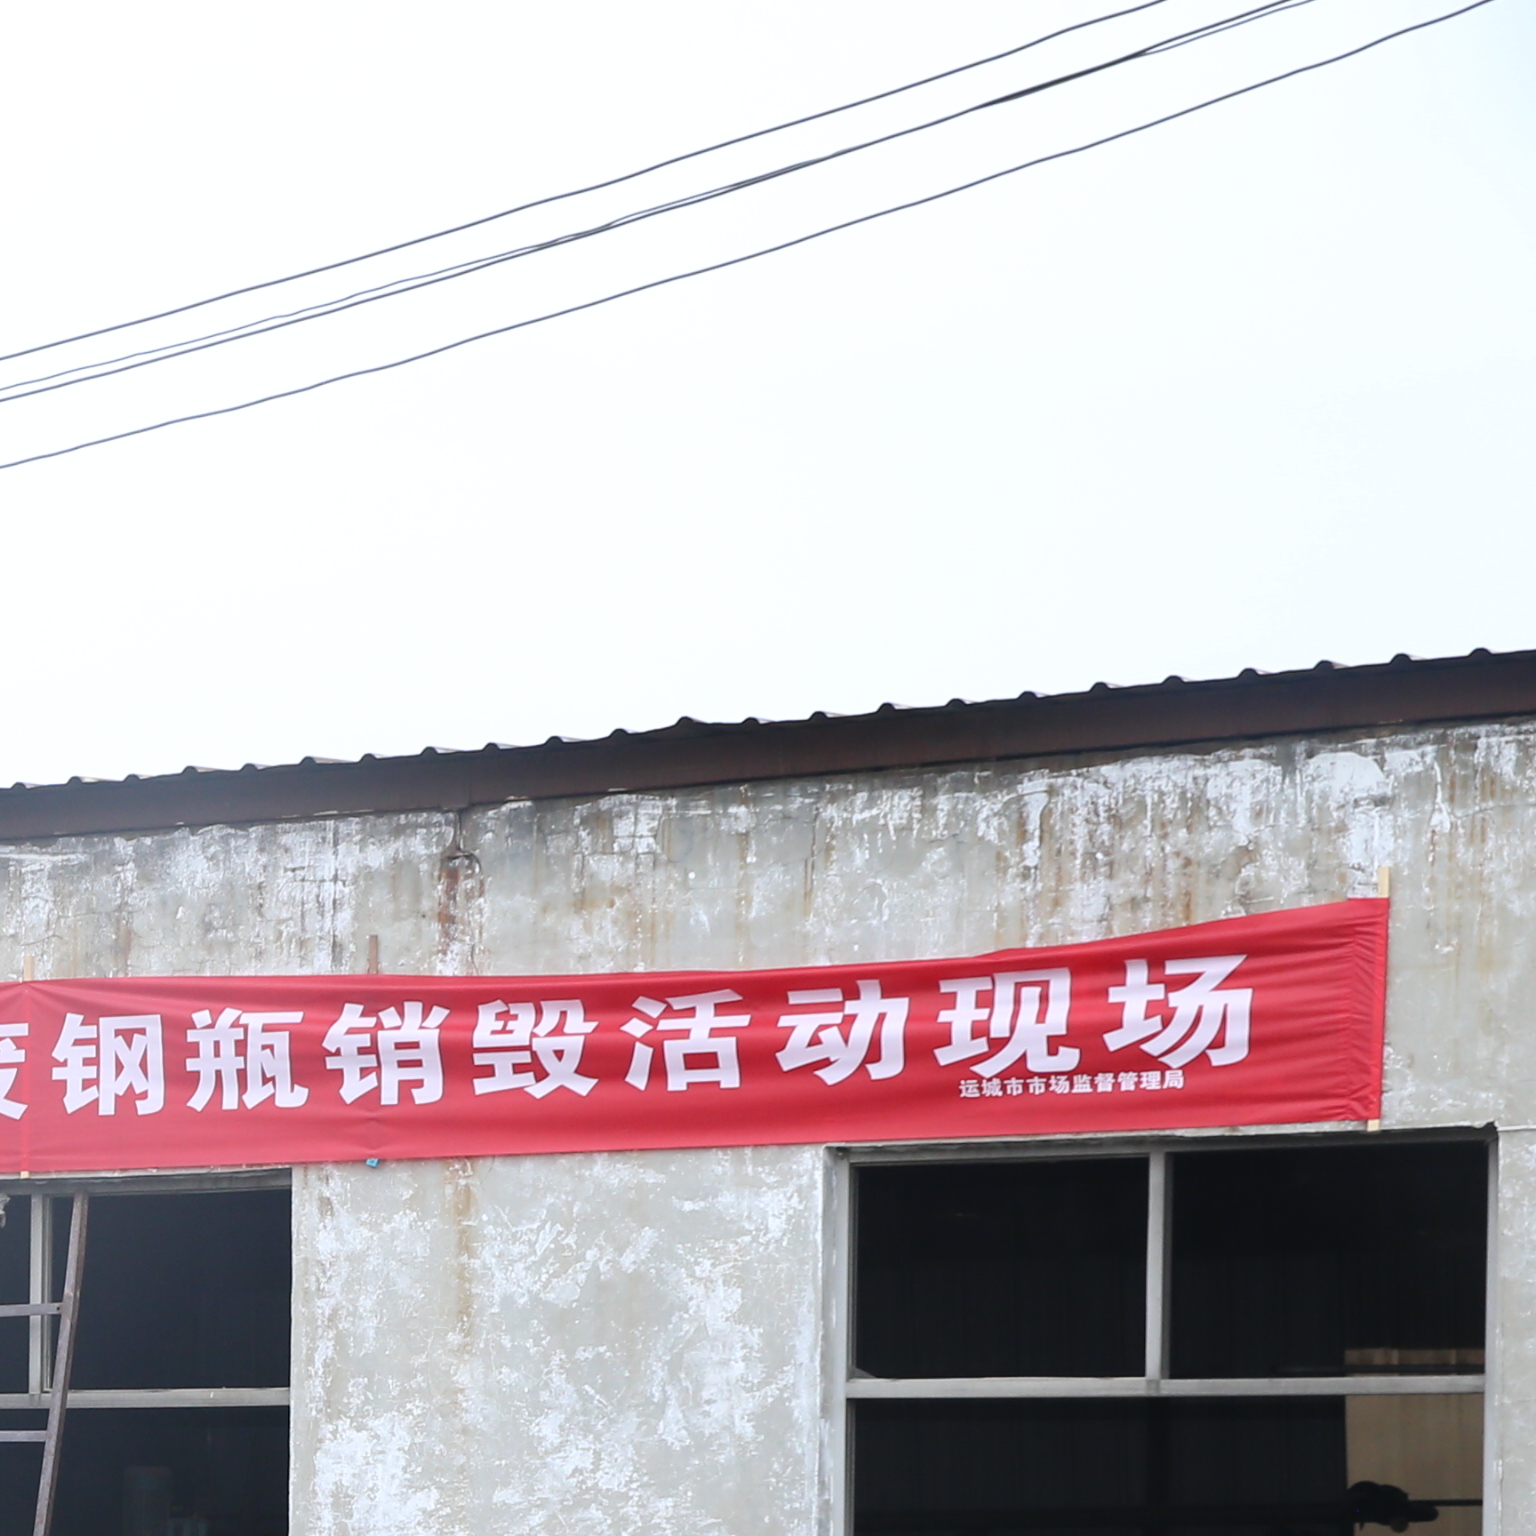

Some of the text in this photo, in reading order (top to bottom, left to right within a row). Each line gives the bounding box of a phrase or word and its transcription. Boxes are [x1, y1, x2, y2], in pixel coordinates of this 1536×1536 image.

[959, 1070, 1185, 1098] 运城市市场监督管理局
